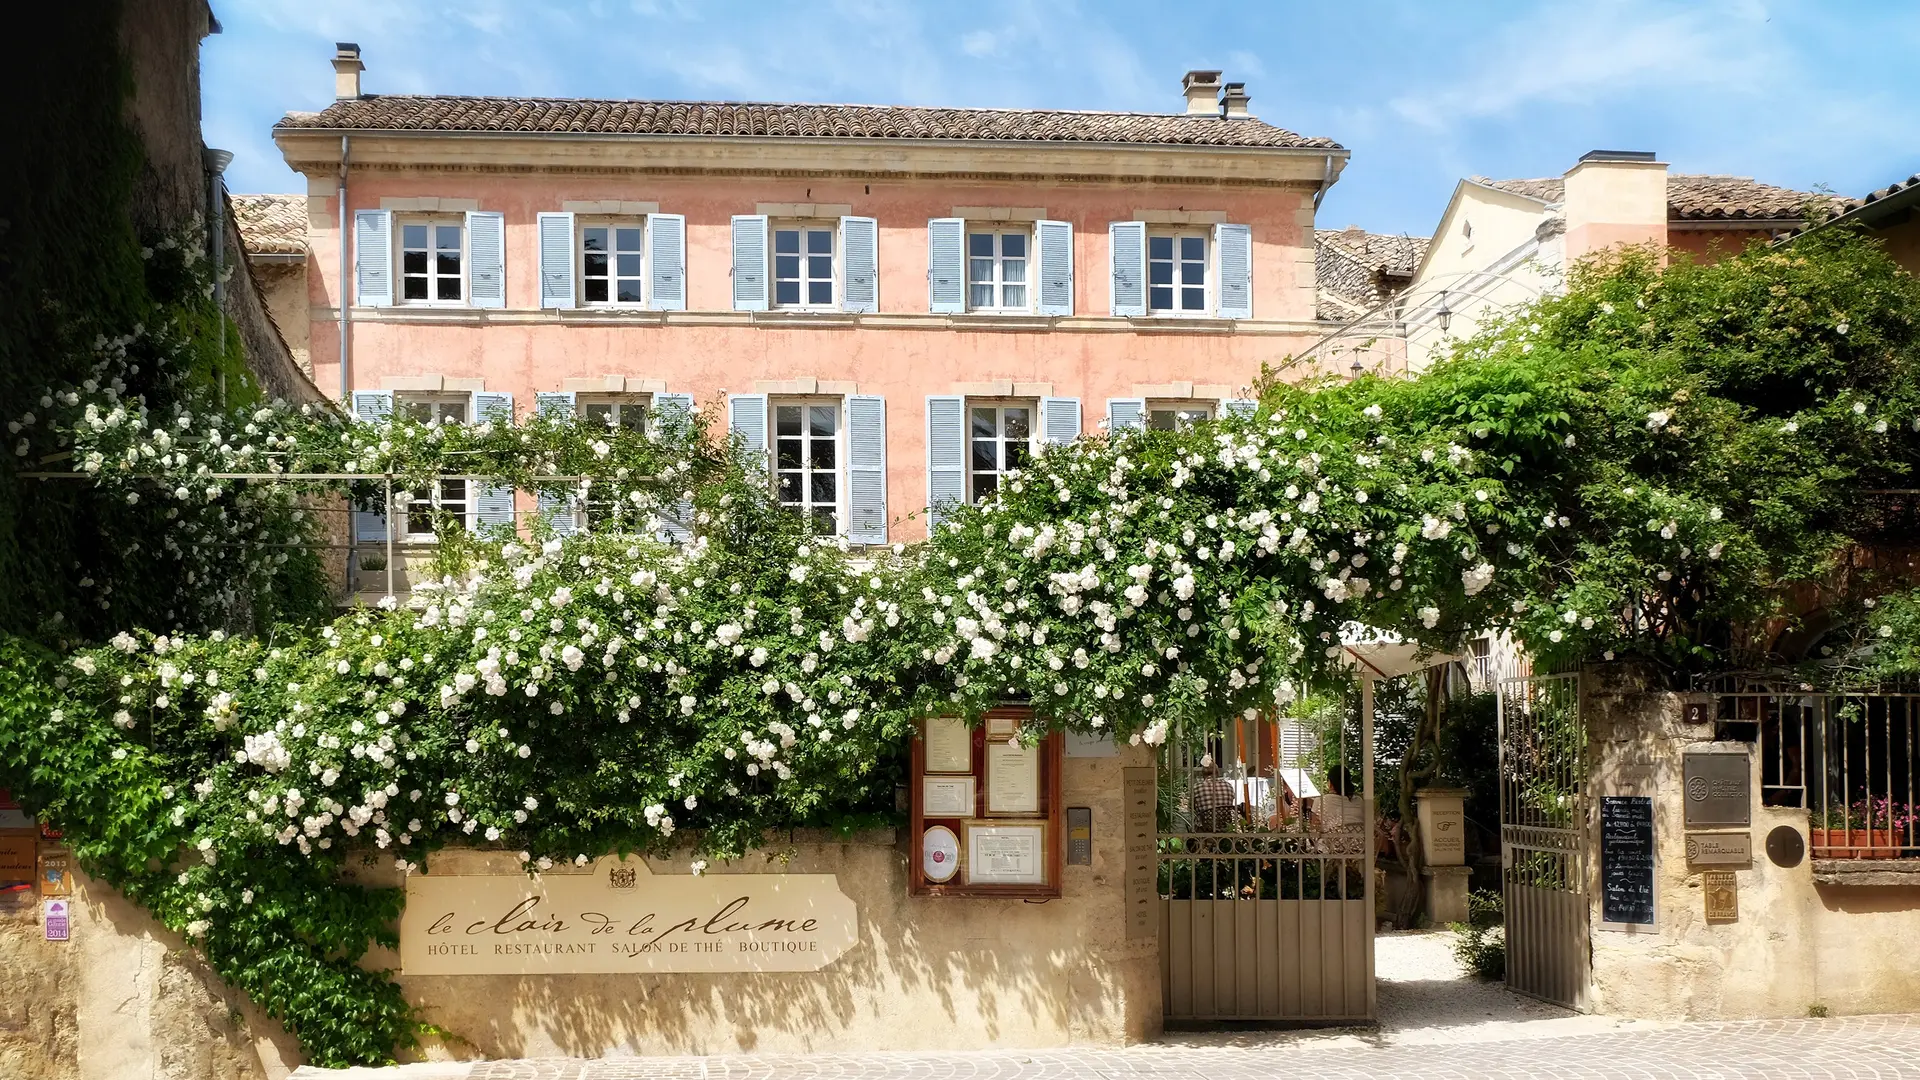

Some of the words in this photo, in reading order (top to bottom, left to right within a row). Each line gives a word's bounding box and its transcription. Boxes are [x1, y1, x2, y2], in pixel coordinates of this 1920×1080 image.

[1691, 707, 1699, 720] 2
[424, 912, 455, 935] le
[465, 896, 570, 935] clair
[580, 912, 621, 935] de
[626, 913, 656, 936] la
[628, 896, 819, 958] plume
[47, 929, 67, 937] 2014
[428, 942, 479, 955] HÔTEL
[494, 943, 596, 954] RESTAURANT
[612, 943, 662, 953] SALON
[669, 942, 688, 953] DE
[695, 939, 723, 952] THÉ
[739, 941, 817, 954] BOUTIQUE
